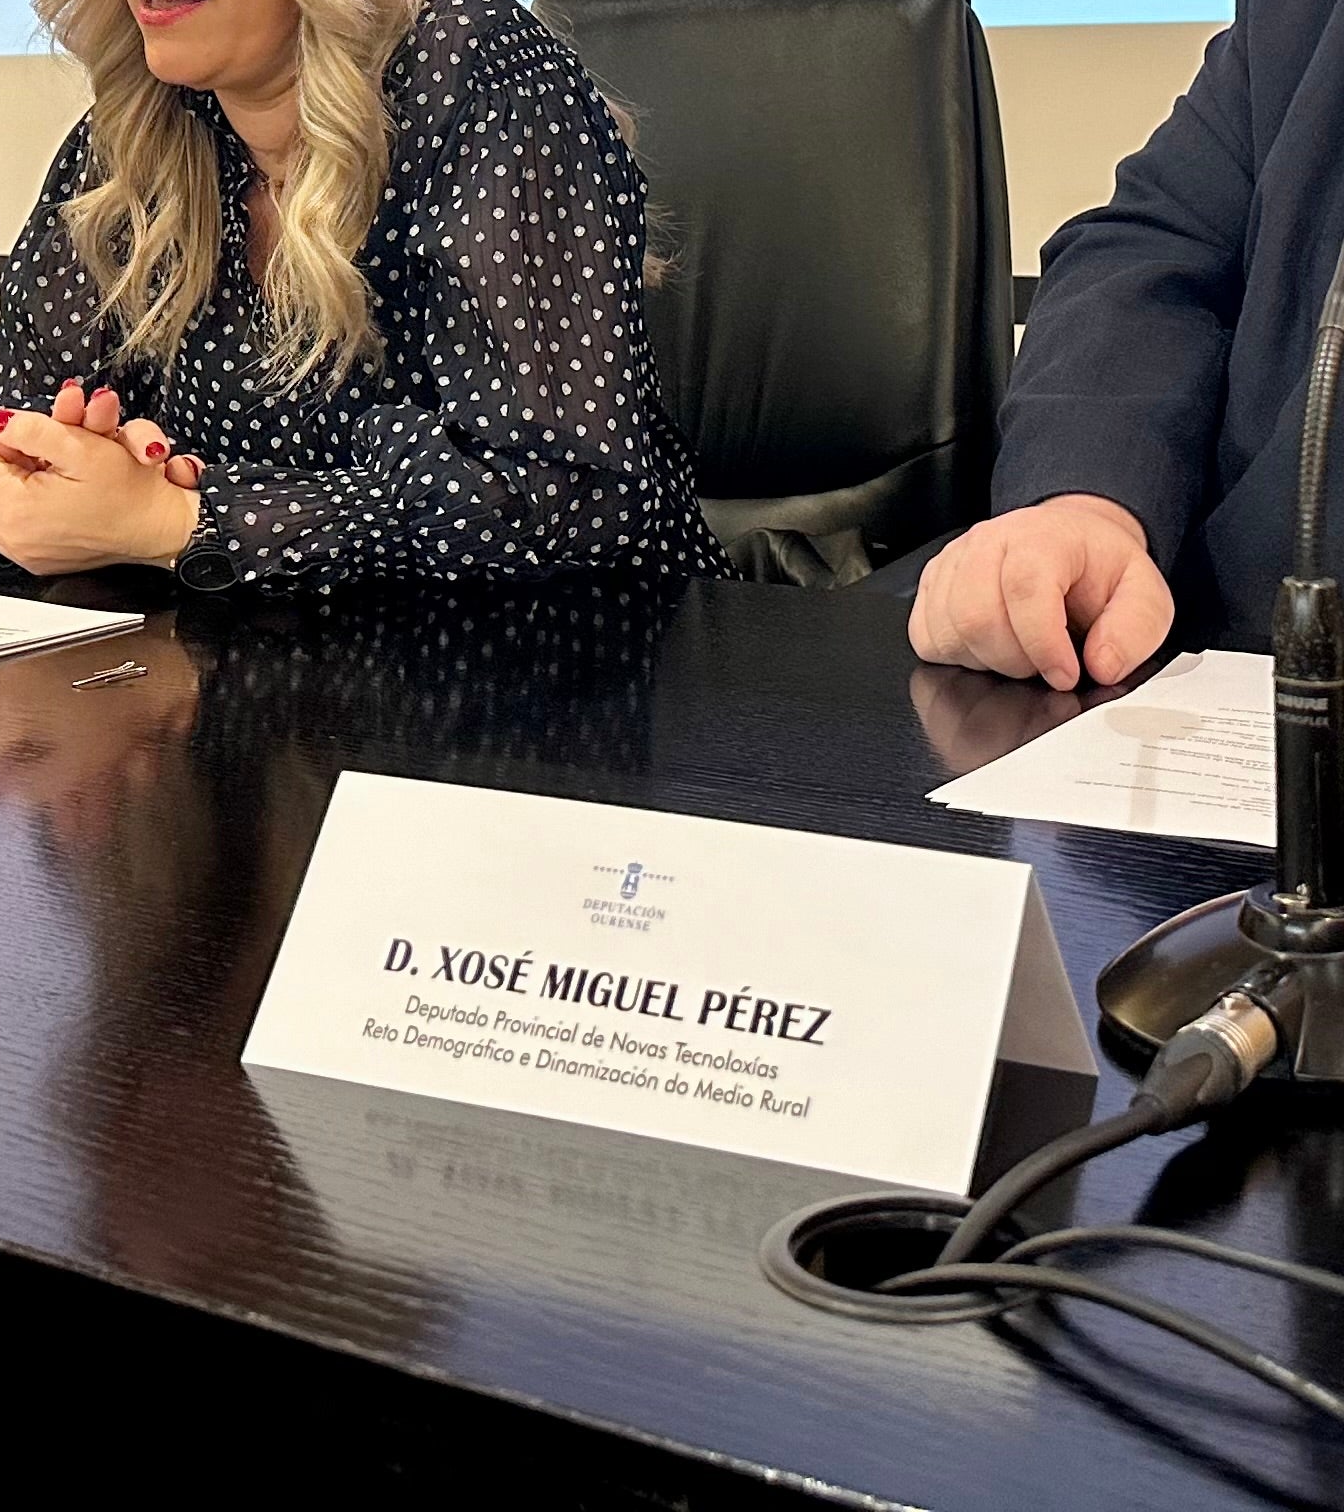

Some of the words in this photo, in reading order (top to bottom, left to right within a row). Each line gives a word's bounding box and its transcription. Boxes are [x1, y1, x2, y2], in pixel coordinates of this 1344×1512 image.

[582, 898, 666, 920] DEPUTACIÓN
[590, 912, 651, 932] OURENSE
[383, 937, 419, 976] D.
[431, 945, 534, 995] XOSÉ
[539, 963, 684, 1022] MIGUEL
[697, 985, 832, 1046] PÉREZ
[362, 1017, 399, 1042] Reto
[403, 1024, 515, 1064] Demográfico
[519, 1051, 531, 1067] e
[535, 1048, 659, 1090] Dinamización
[664, 1072, 690, 1096] do
[693, 1078, 754, 1109] Medio
[759, 1089, 812, 1119] Rural
[405, 994, 489, 1028] Deputado
[493, 1009, 580, 1044] Provincial
[581, 1025, 605, 1049] de
[609, 1031, 668, 1060] Novas
[675, 1041, 779, 1080] Tecnoloxías
